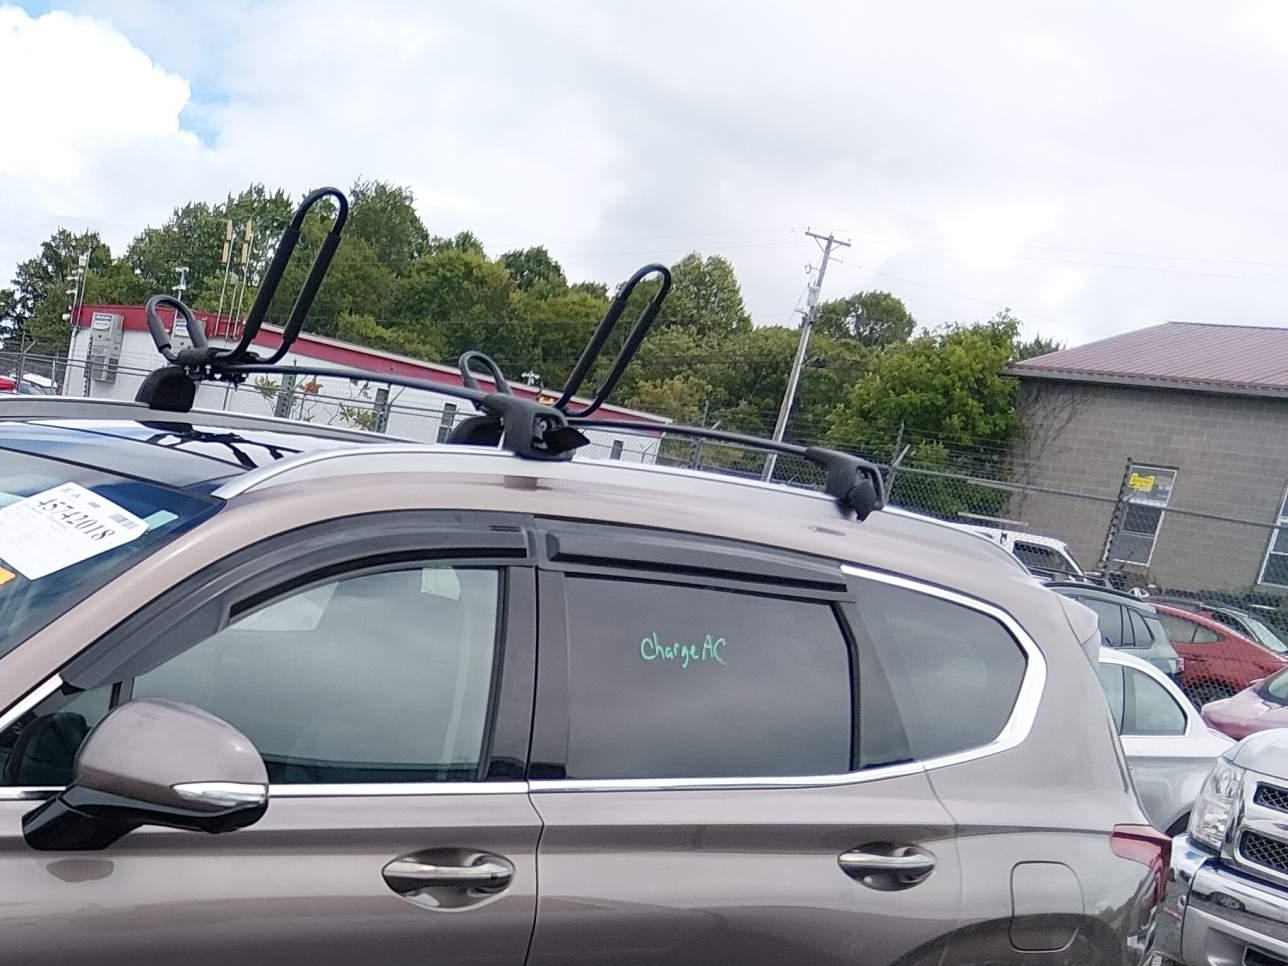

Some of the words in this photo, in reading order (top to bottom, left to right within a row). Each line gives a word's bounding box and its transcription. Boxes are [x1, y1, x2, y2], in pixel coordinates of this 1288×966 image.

[37, 498, 116, 541] 45742018
[640, 632, 699, 668] Charge
[702, 634, 727, 665] AC
